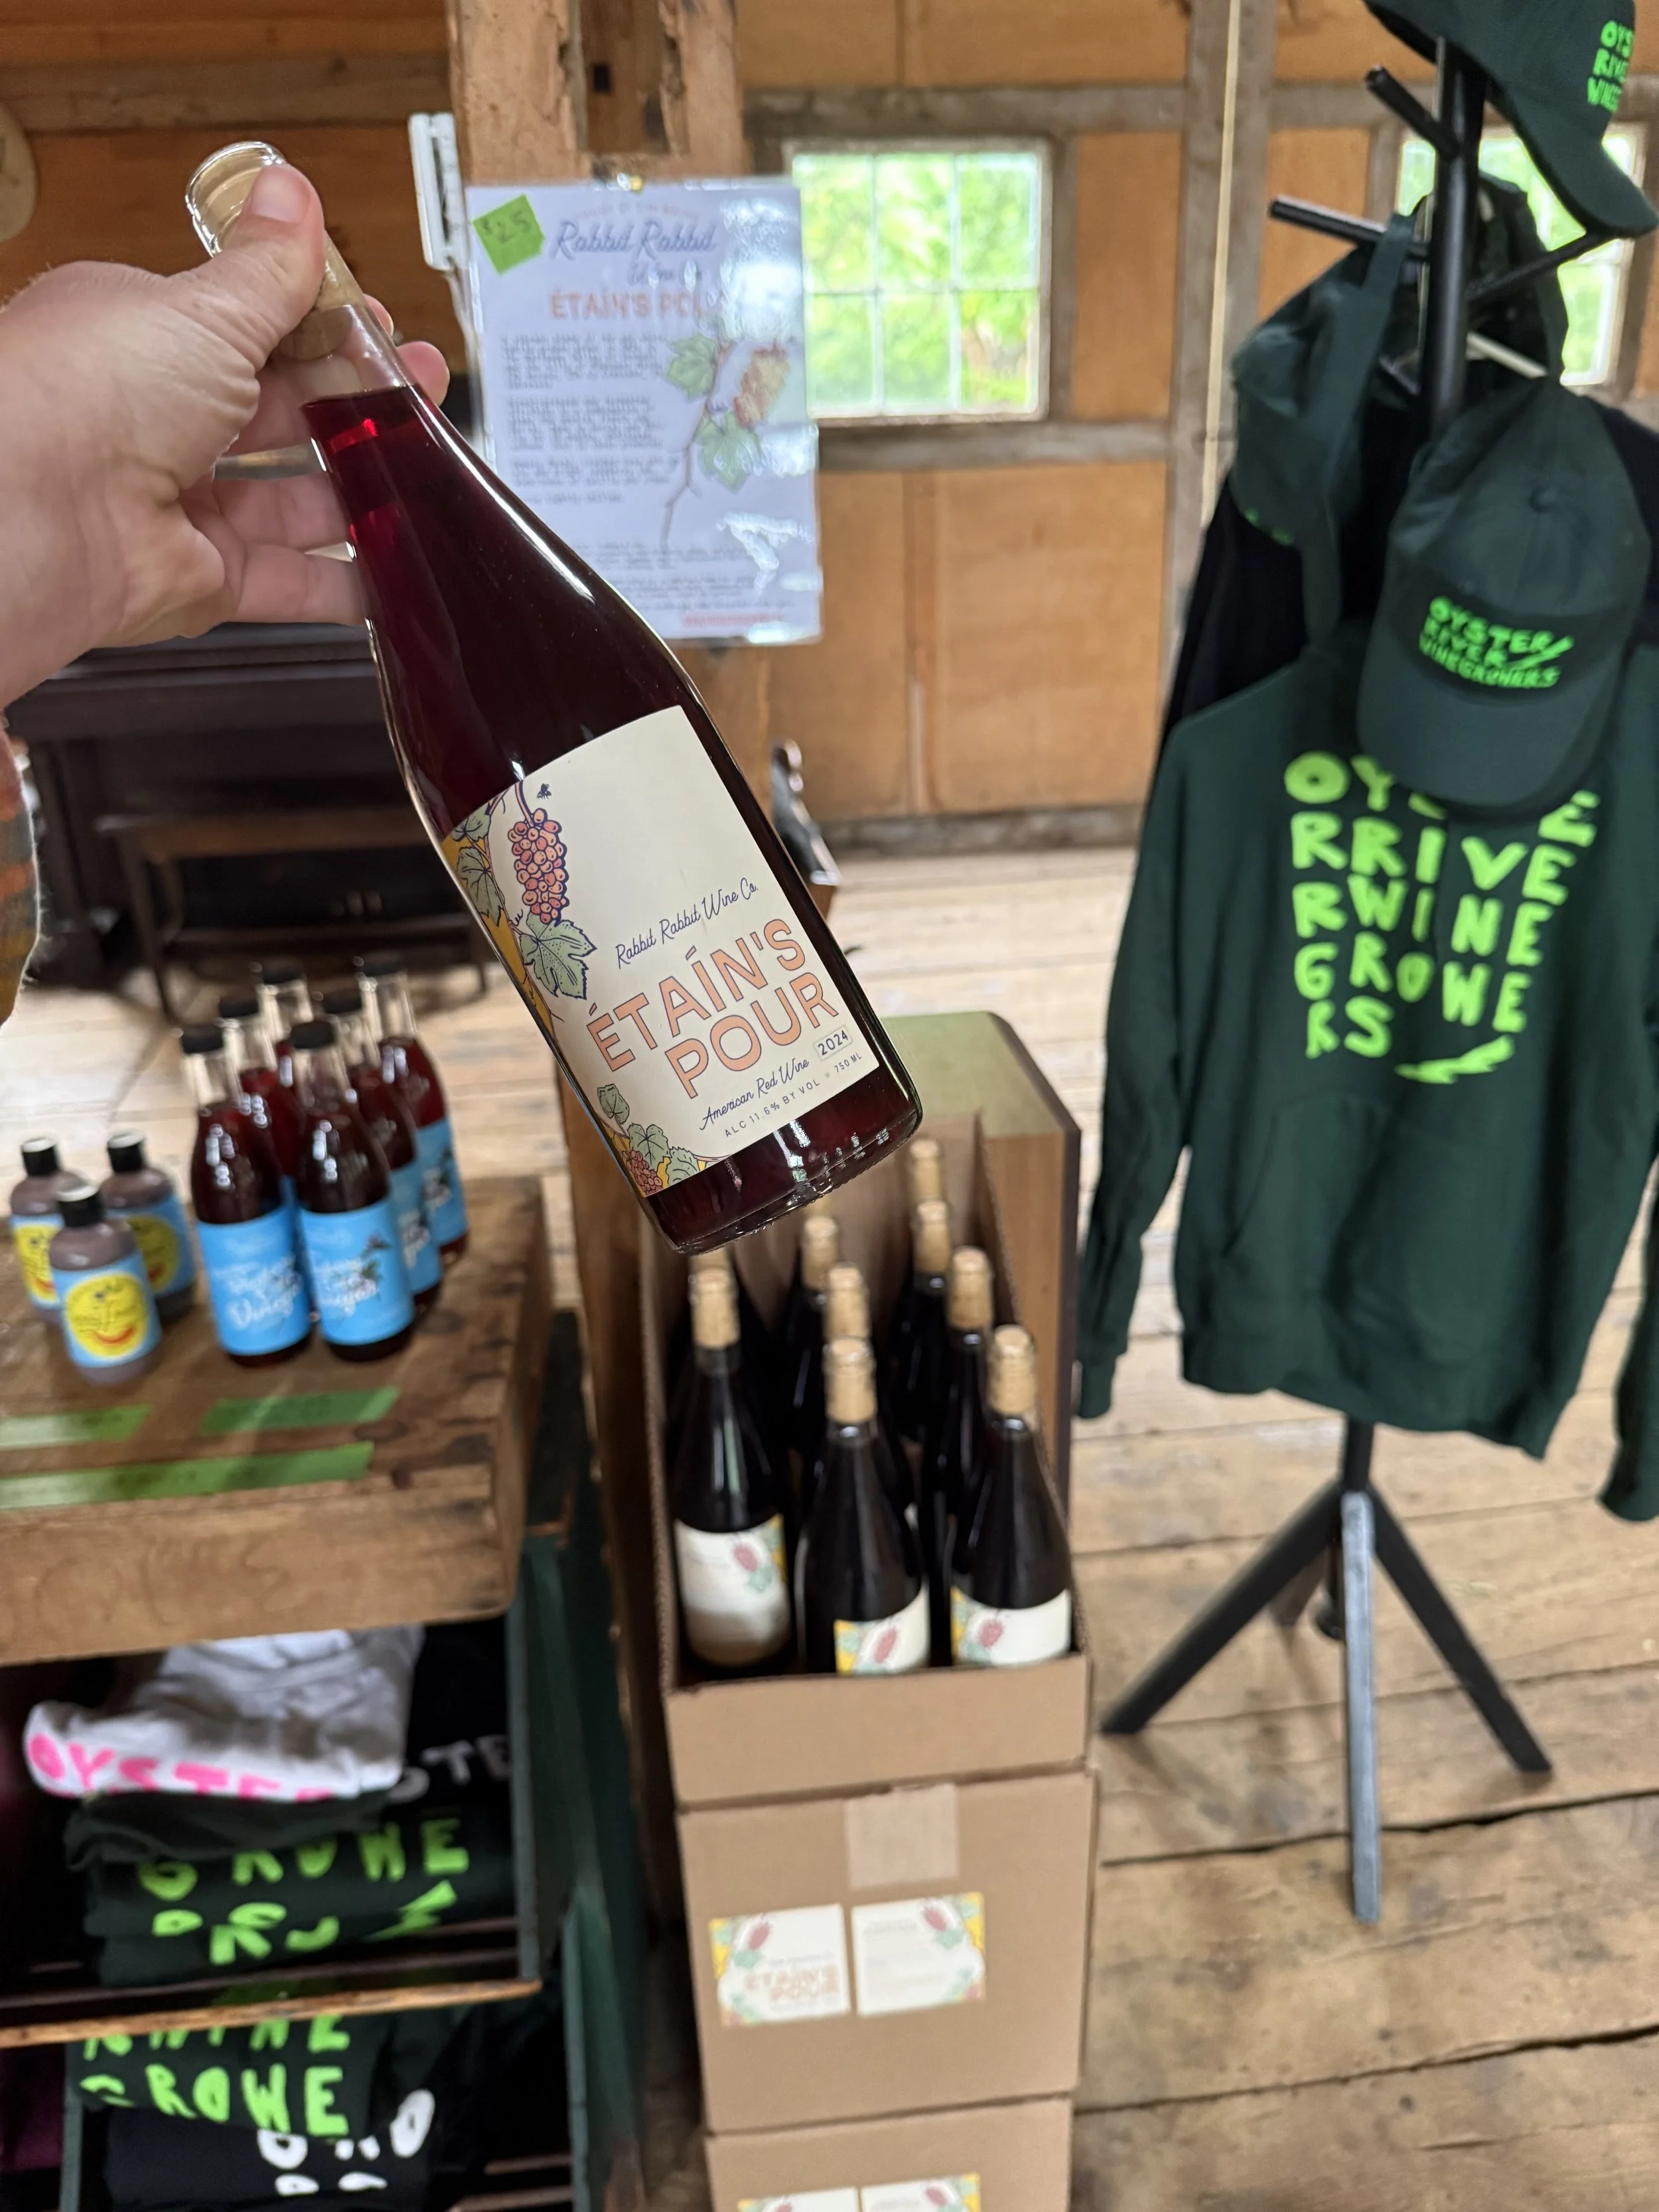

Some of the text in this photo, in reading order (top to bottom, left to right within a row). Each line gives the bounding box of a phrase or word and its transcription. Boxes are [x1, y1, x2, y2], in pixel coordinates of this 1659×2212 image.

[1429, 596, 1555, 654] OYSTER
[1284, 751, 1601, 848] OYE
[615, 877, 758, 970] Rabbit Rabbit Wine Co.
[585, 918, 806, 1072] ÉTAÍN'S
[664, 972, 839, 1100] POUR
[699, 1029, 849, 1131] American Red Wine 2024
[725, 1120, 747, 1138] ALC
[782, 1092, 796, 1105] BY
[798, 1078, 821, 1095] VOL
[833, 1060, 851, 1074] 750
[850, 1052, 863, 1063] ML
